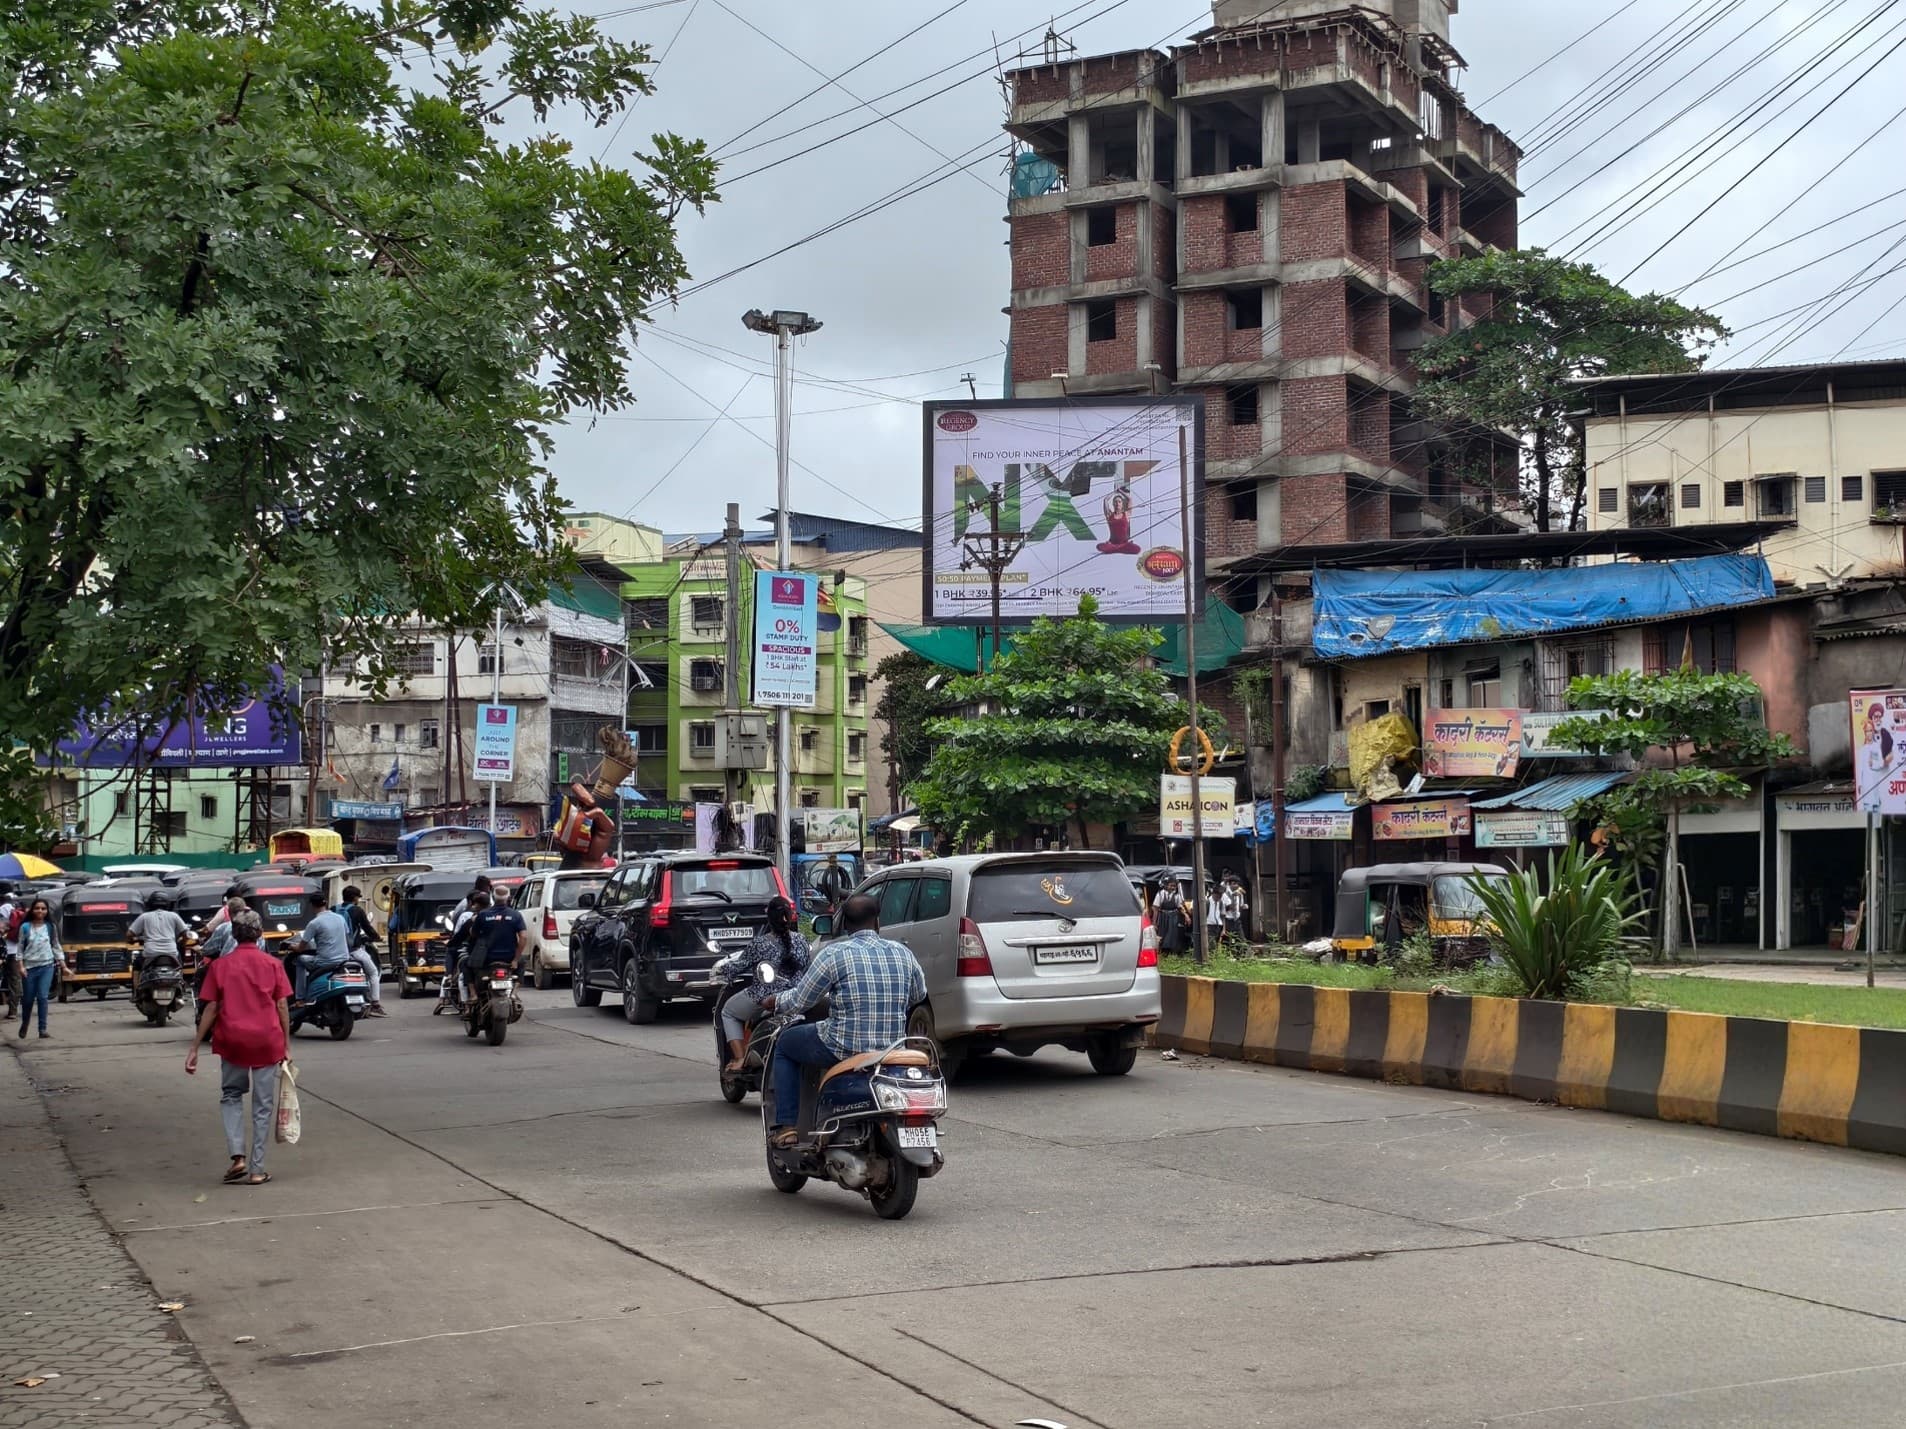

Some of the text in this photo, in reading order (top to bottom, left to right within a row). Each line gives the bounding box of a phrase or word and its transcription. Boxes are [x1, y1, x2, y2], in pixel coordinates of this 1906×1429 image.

[972, 451, 994, 460] FIND
[996, 451, 1021, 459] YOUR
[1023, 450, 1051, 458] INNER
[1053, 449, 1081, 457] PEACE
[1097, 447, 1144, 456] ANANTAM
[953, 460, 1161, 541] NXT
[937, 575, 959, 583] 50:50
[943, 590, 966, 598] BHK
[1031, 588, 1037, 597] 2
[1039, 588, 1063, 597] BHK
[775, 618, 800, 634] 0%
[765, 633, 788, 641] STAMP
[768, 645, 805, 654] SPACIOUS
[762, 691, 781, 700] 7506
[792, 692, 804, 701] 201
[204, 718, 247, 734] NG
